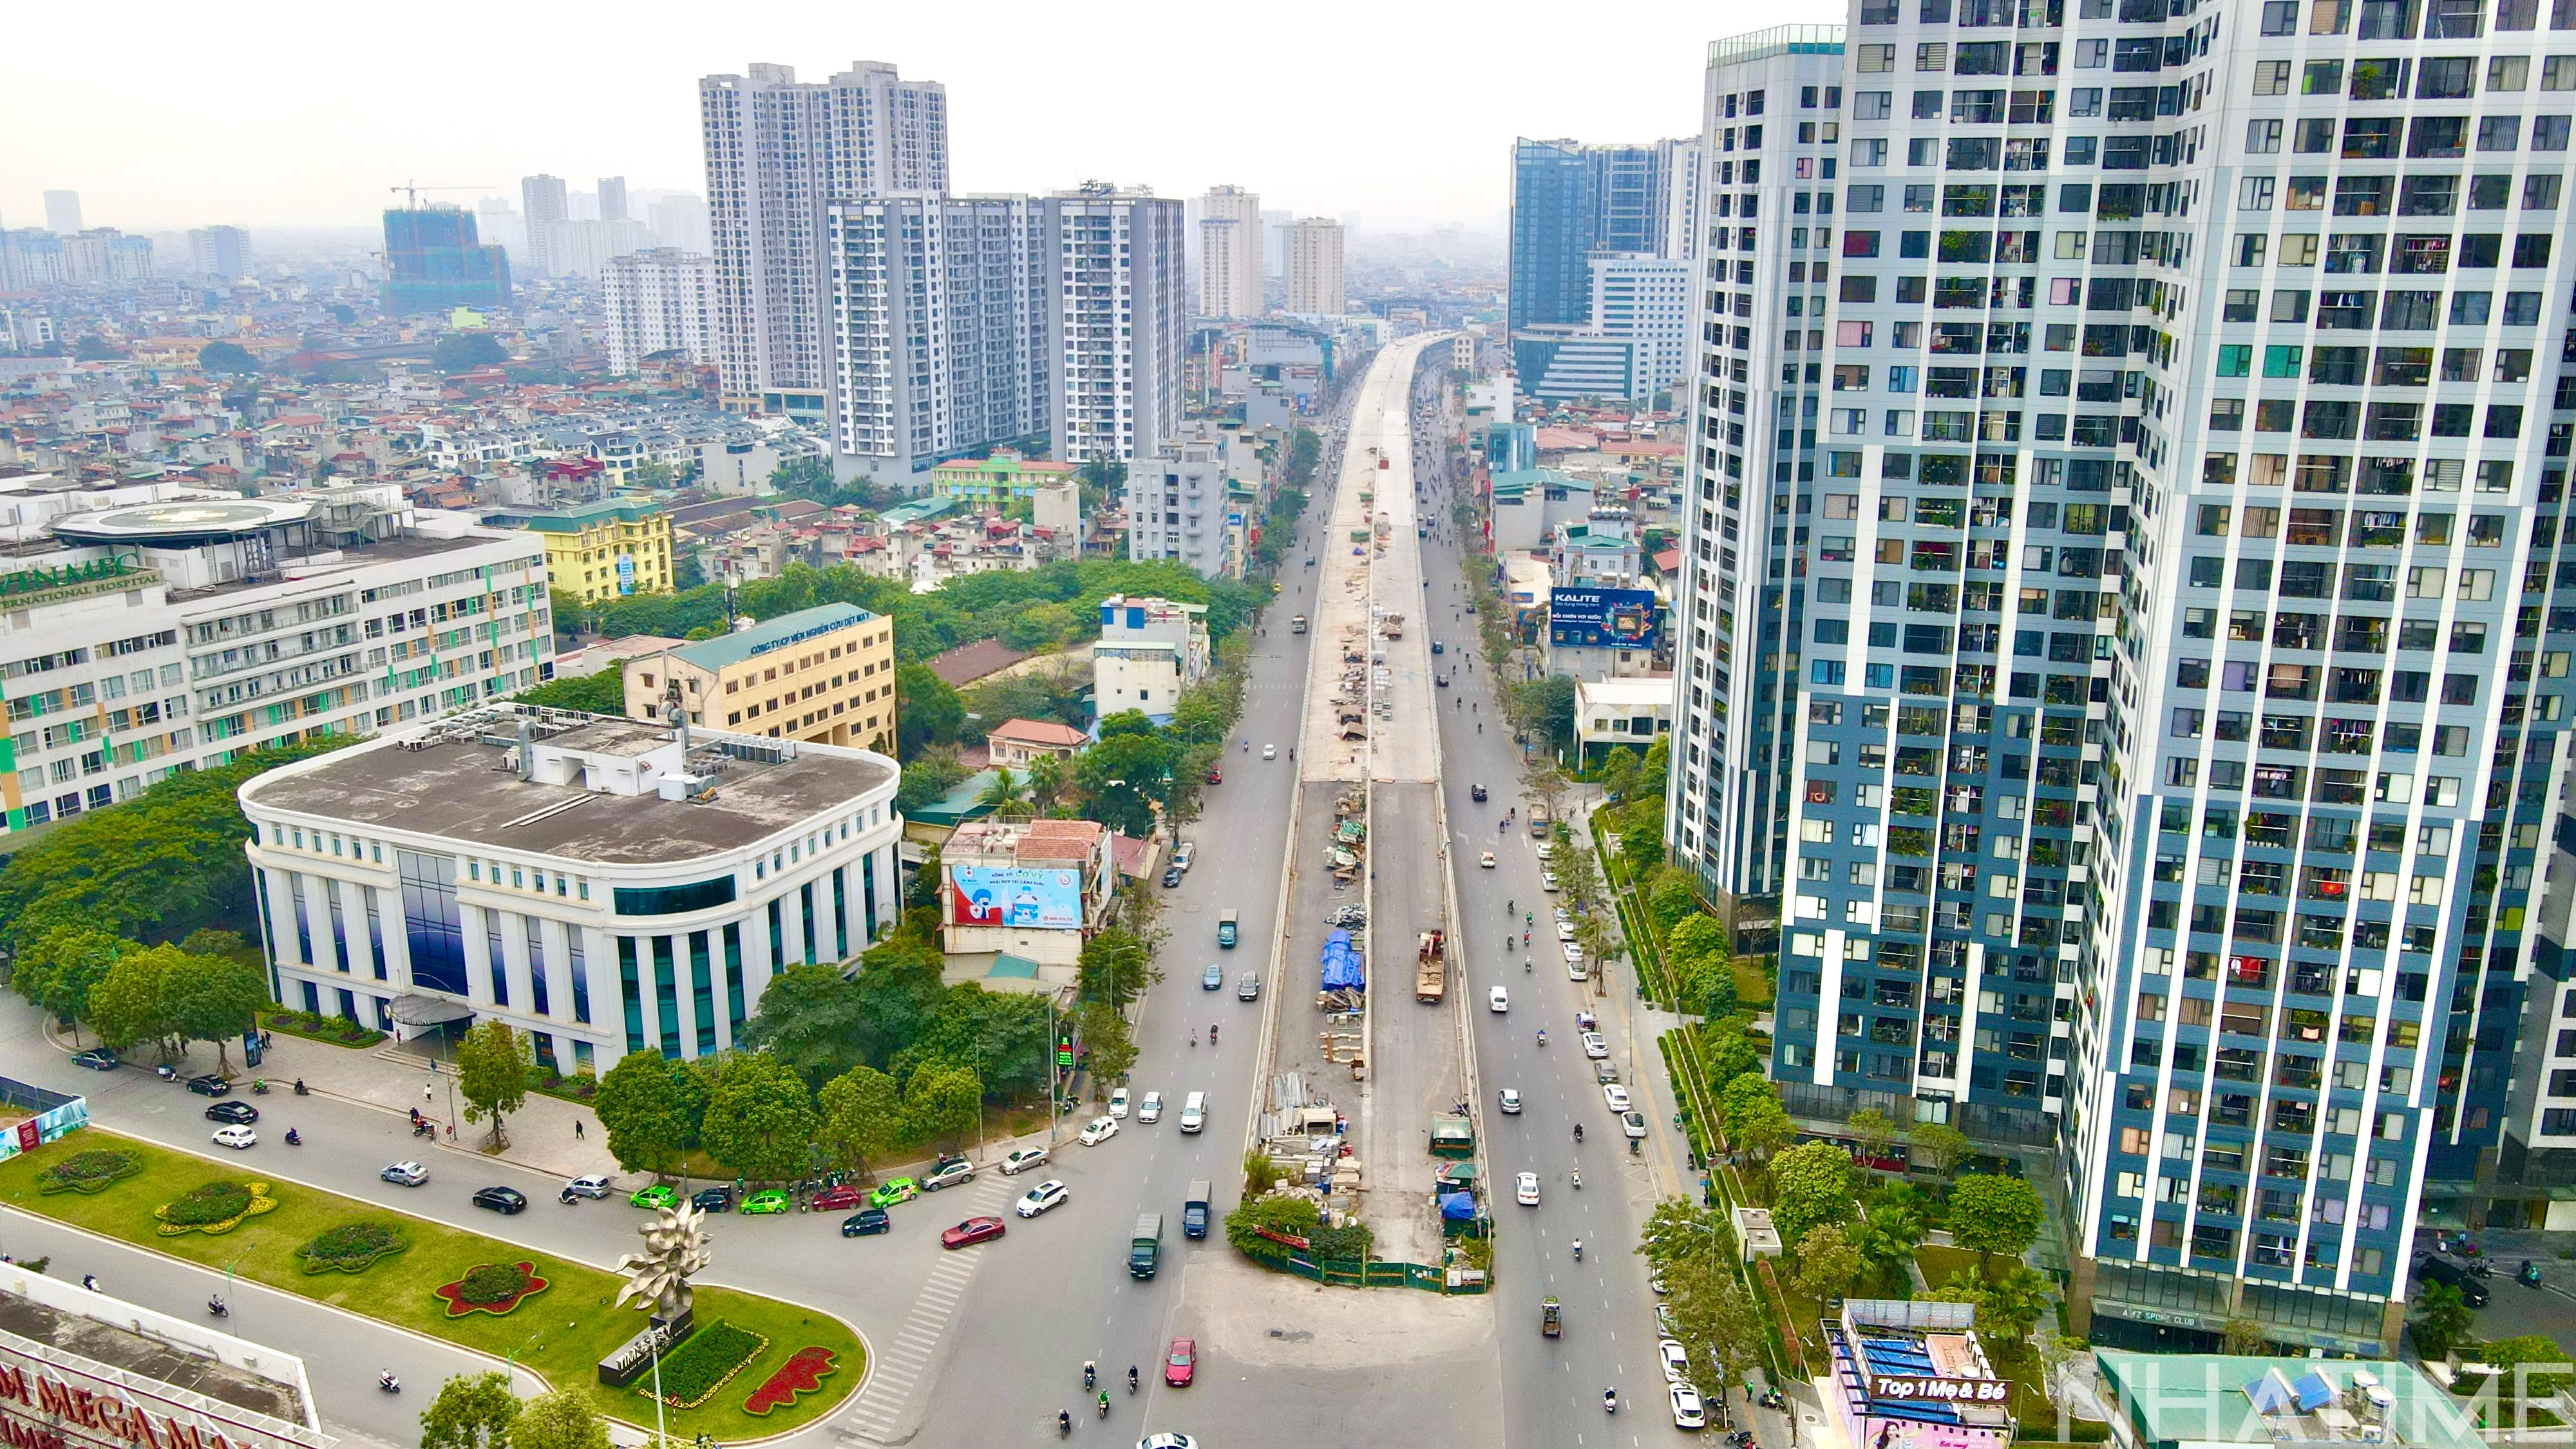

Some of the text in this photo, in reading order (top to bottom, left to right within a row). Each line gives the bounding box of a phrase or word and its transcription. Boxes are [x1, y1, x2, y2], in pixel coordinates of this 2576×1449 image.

[95, 574, 159, 592] HOSPITAL
[1555, 594, 1600, 603] KALITE
[772, 639, 780, 649] TY
[781, 636, 790, 645] CP
[2174, 1316, 2195, 1326] CLUB
[1878, 1378, 1915, 1399] Top
[1977, 1383, 2005, 1399] Bé
[37, 1374, 162, 1449] MEGA
